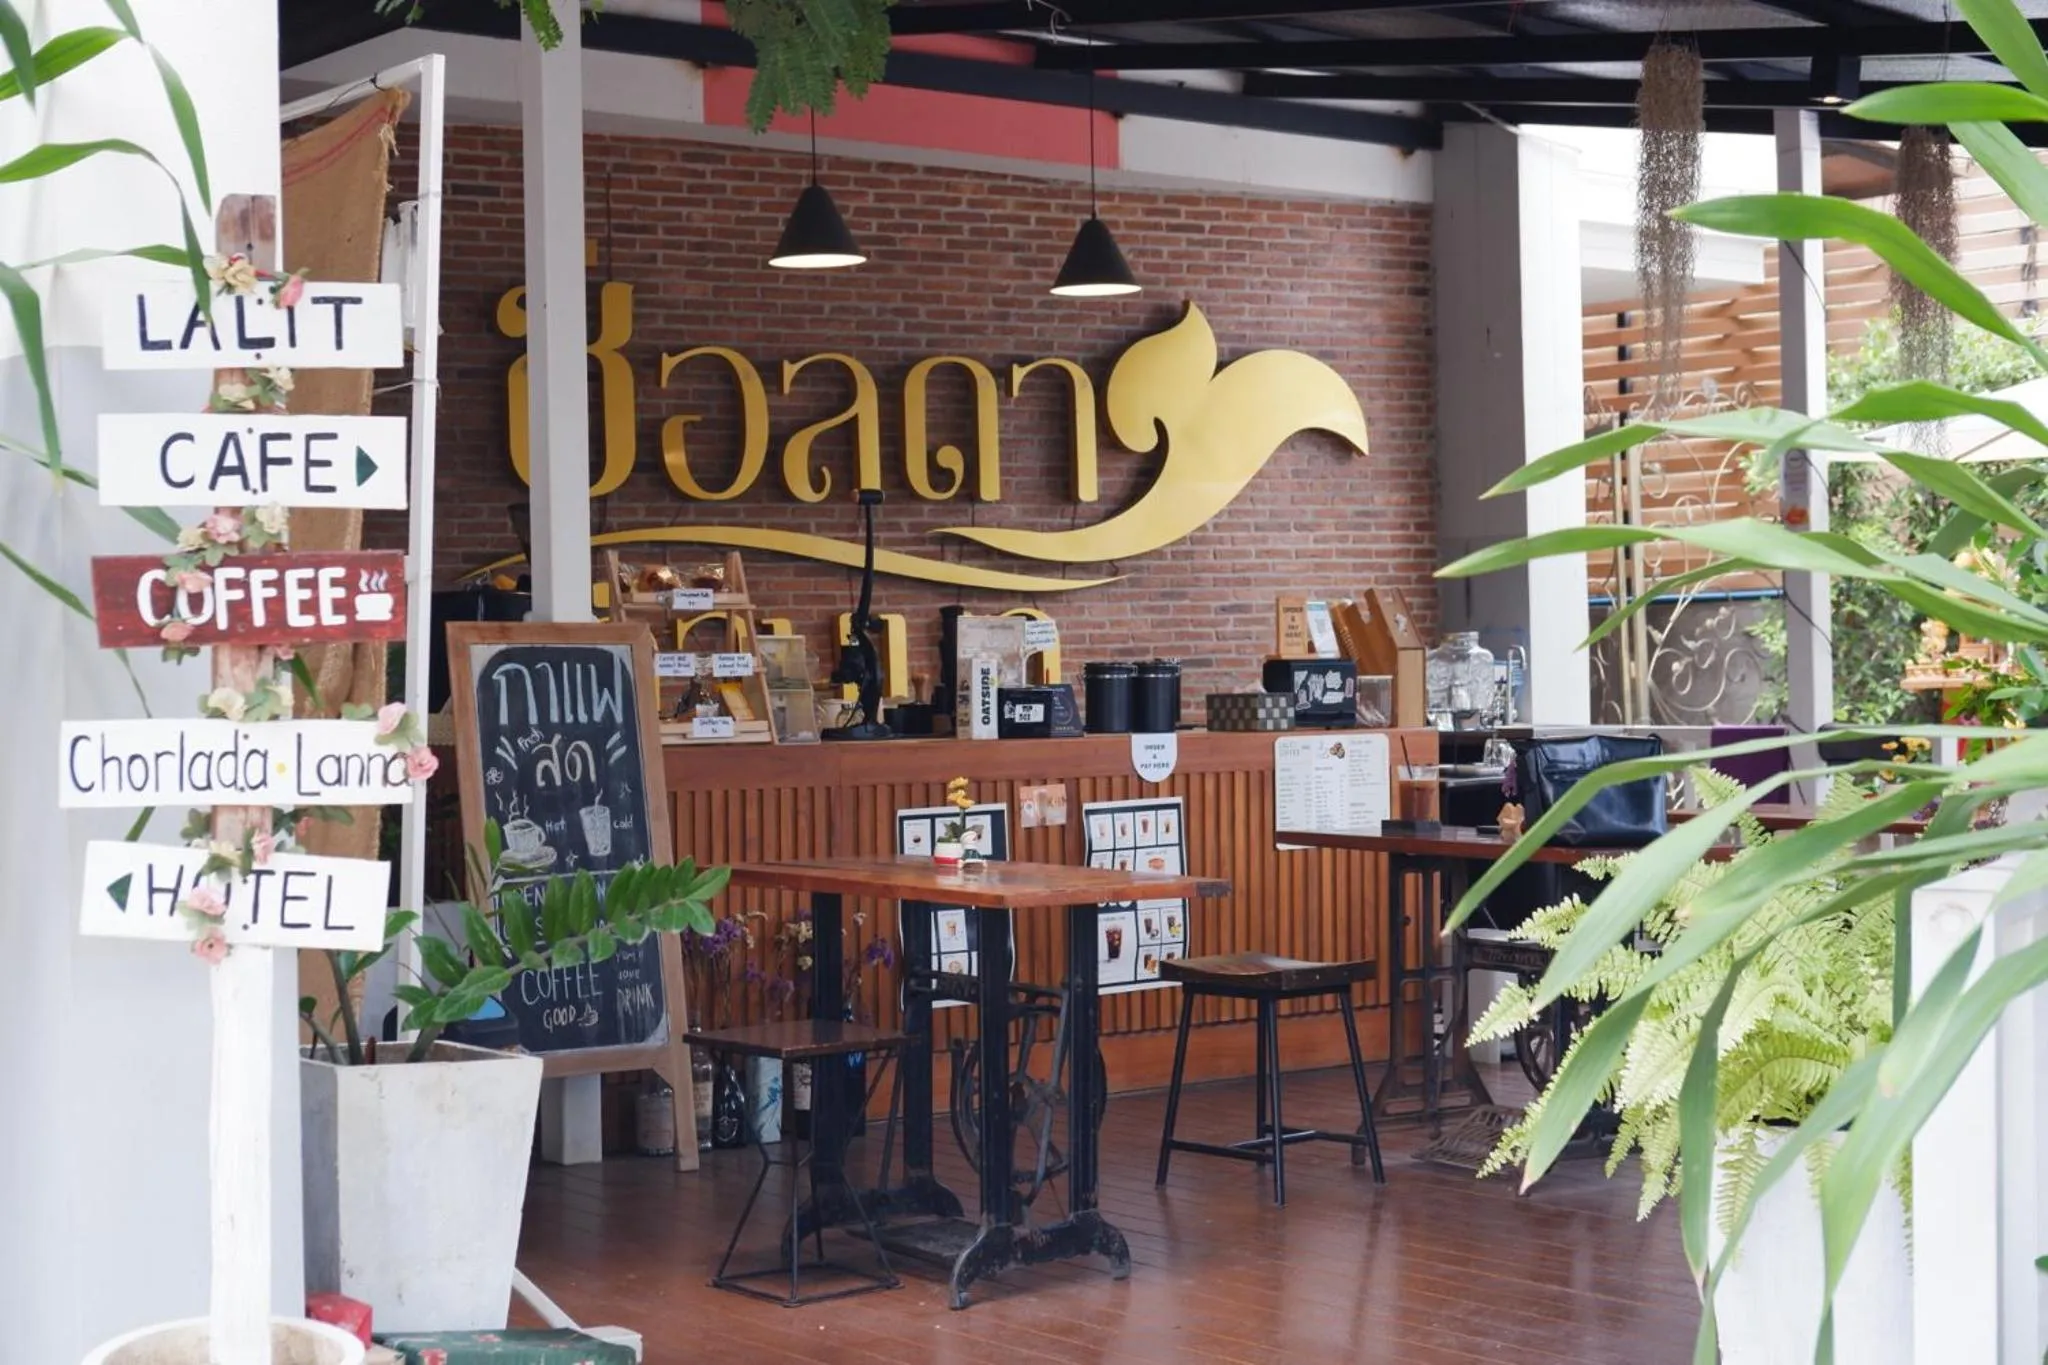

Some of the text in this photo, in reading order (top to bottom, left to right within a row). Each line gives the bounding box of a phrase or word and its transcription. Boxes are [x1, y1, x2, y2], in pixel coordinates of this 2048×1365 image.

[136, 293, 363, 352] LALIT
[160, 431, 339, 494] CAFE
[136, 566, 347, 630] COFFEE
[980, 667, 991, 726] OATSIDE
[69, 729, 411, 797] Chorlada Lanna
[531, 733, 597, 788] สด
[520, 960, 603, 1005] COFFEE
[542, 1004, 577, 1034] GOOD
